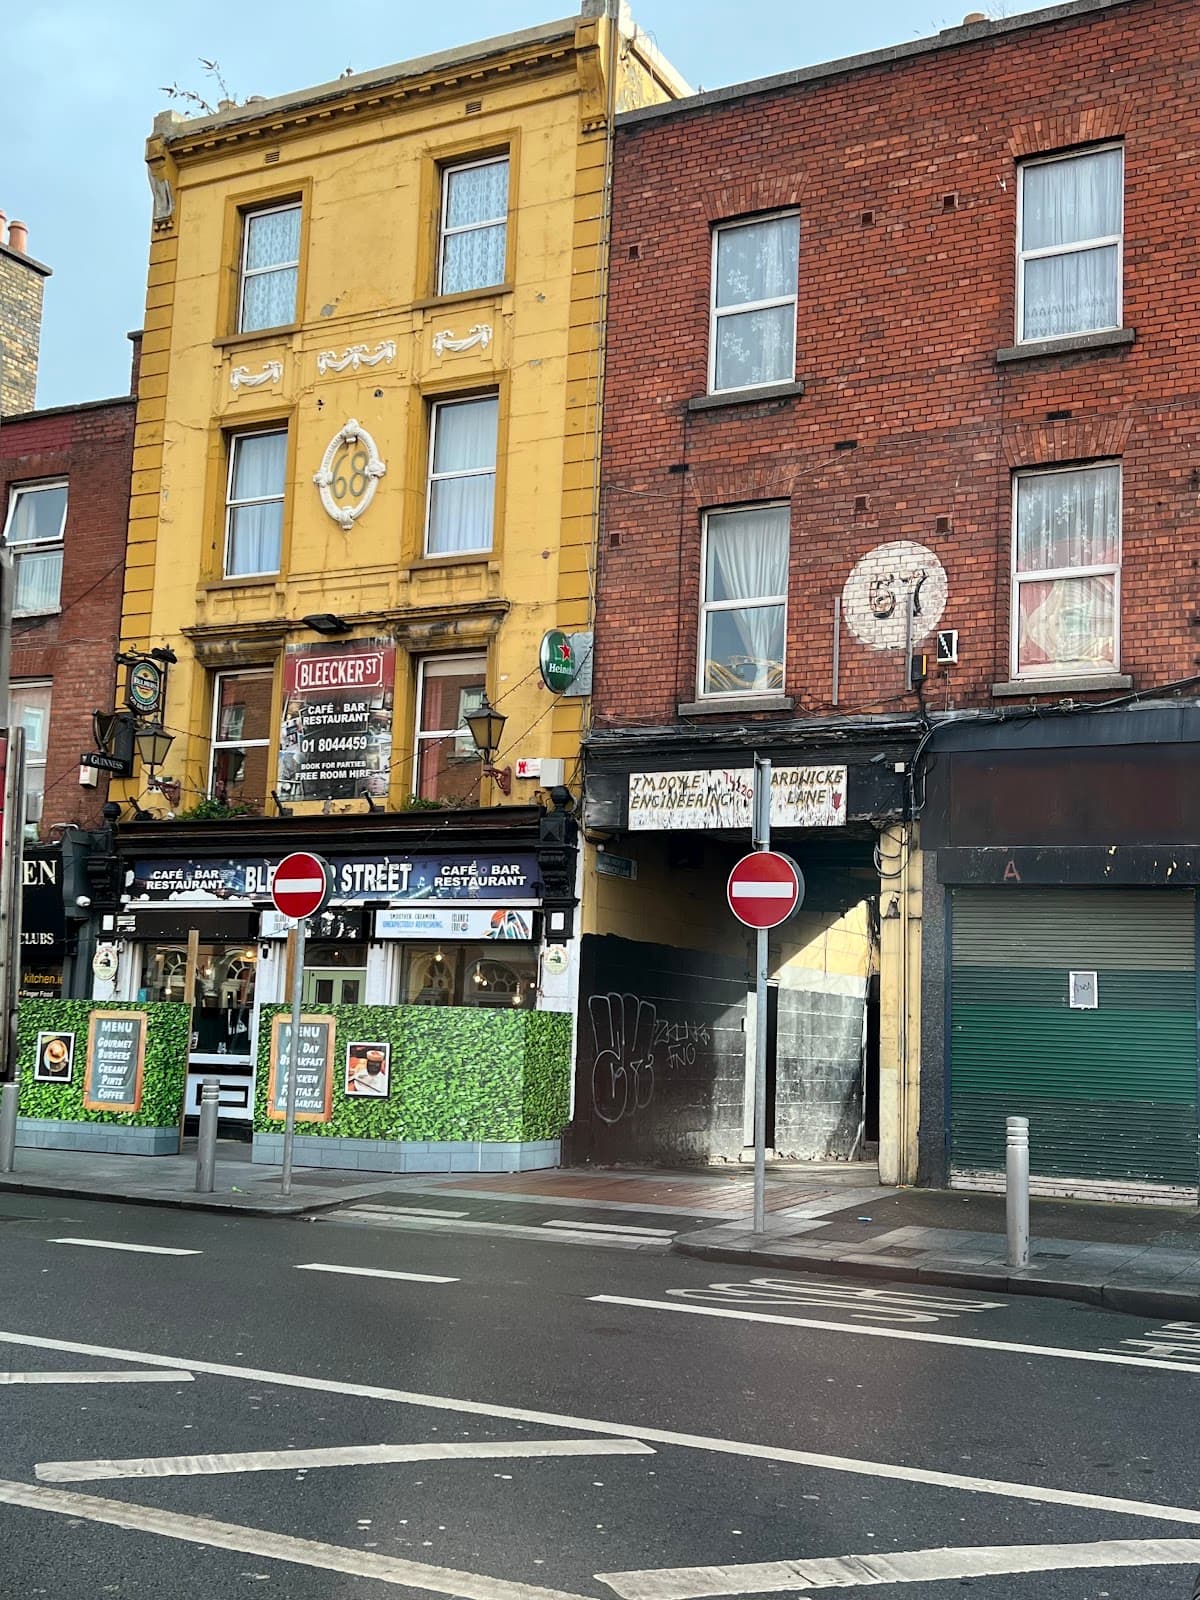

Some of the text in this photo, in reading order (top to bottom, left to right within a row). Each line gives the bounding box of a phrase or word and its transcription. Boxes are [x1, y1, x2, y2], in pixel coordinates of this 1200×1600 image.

[333, 451, 368, 499] 68
[301, 659, 378, 687] BLEECKER ST
[308, 703, 365, 715] CAFÉ BAR
[302, 713, 370, 726] RESTAURANT
[302, 737, 368, 752] 01 8044459
[90, 754, 124, 770] GUINNESS
[336, 760, 367, 769] PARTIES
[295, 772, 318, 781] FREE
[320, 772, 347, 780] ROOM
[770, 769, 845, 786] ARDWICKE
[631, 792, 732, 809] ENGINEERING
[787, 789, 827, 806] LANE
[153, 868, 220, 880] CAFÉ BAR
[441, 863, 520, 876] CAFÉ BAR
[341, 862, 412, 892] STREET
[434, 875, 527, 887] RESTAURANT
[146, 879, 224, 890] RESTAURANT
[101, 1021, 133, 1033] MENU
[97, 1037, 133, 1049] GOURMET
[302, 1043, 320, 1054] DAY
[97, 1048, 131, 1061] BURGERS
[98, 1063, 128, 1075] CREAMY
[101, 1075, 125, 1086] PINTS
[97, 1088, 126, 1100] COFFEE
[666, 1277, 1009, 1322] BUS
